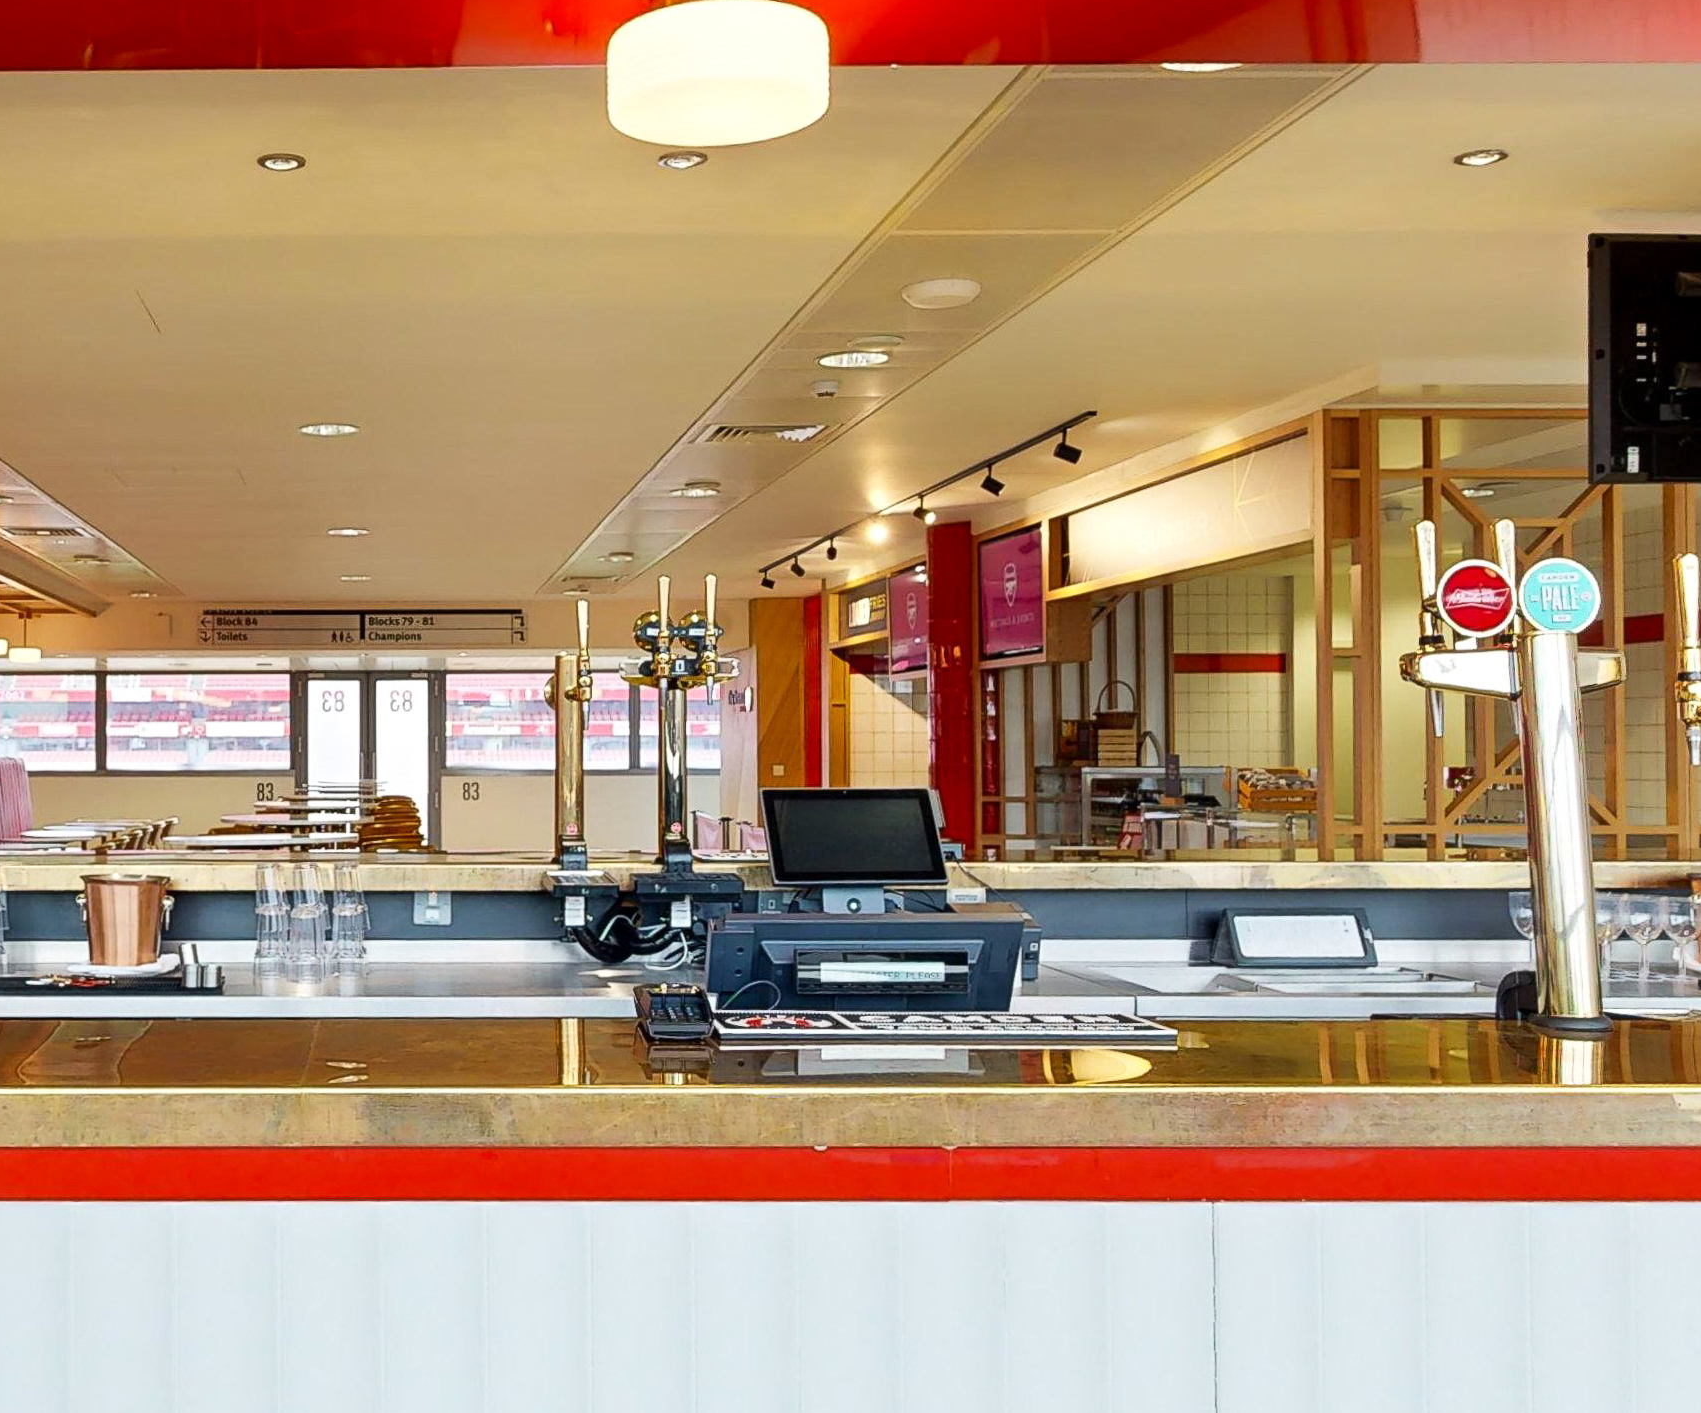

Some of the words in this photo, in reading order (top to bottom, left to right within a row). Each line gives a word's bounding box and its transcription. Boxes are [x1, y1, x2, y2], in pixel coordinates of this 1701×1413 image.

[1540, 585, 1580, 612] PALE
[216, 616, 243, 626] Block
[245, 616, 258, 626] 84
[368, 616, 401, 626] Blocks
[402, 617, 414, 626] 79
[422, 617, 435, 626] 81
[216, 631, 248, 641] Toilets
[368, 632, 422, 643] Champions
[256, 782, 274, 801] 83
[462, 781, 480, 801] 83
[906, 971, 943, 981] PLEASE
